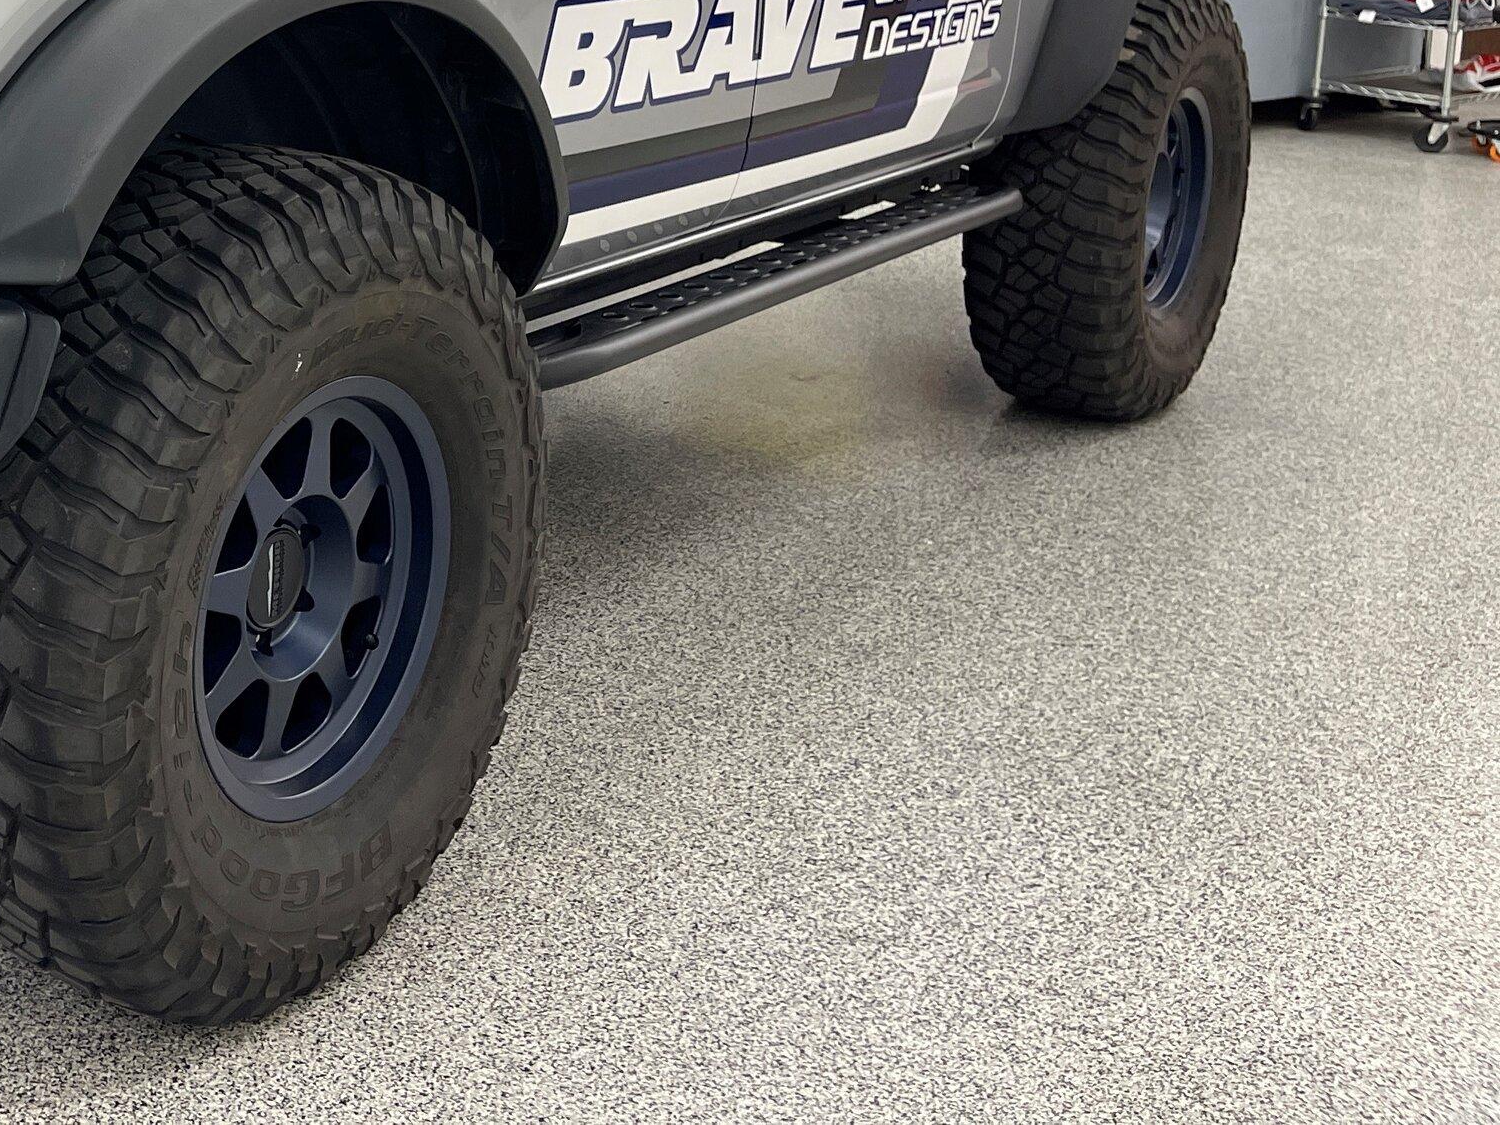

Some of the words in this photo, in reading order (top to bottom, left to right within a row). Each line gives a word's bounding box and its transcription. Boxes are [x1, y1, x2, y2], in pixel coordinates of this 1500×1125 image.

[308, 315, 508, 480] Mud-Terrain
[488, 493, 513, 605] T/A
[172, 620, 393, 913] BFGoodrich
